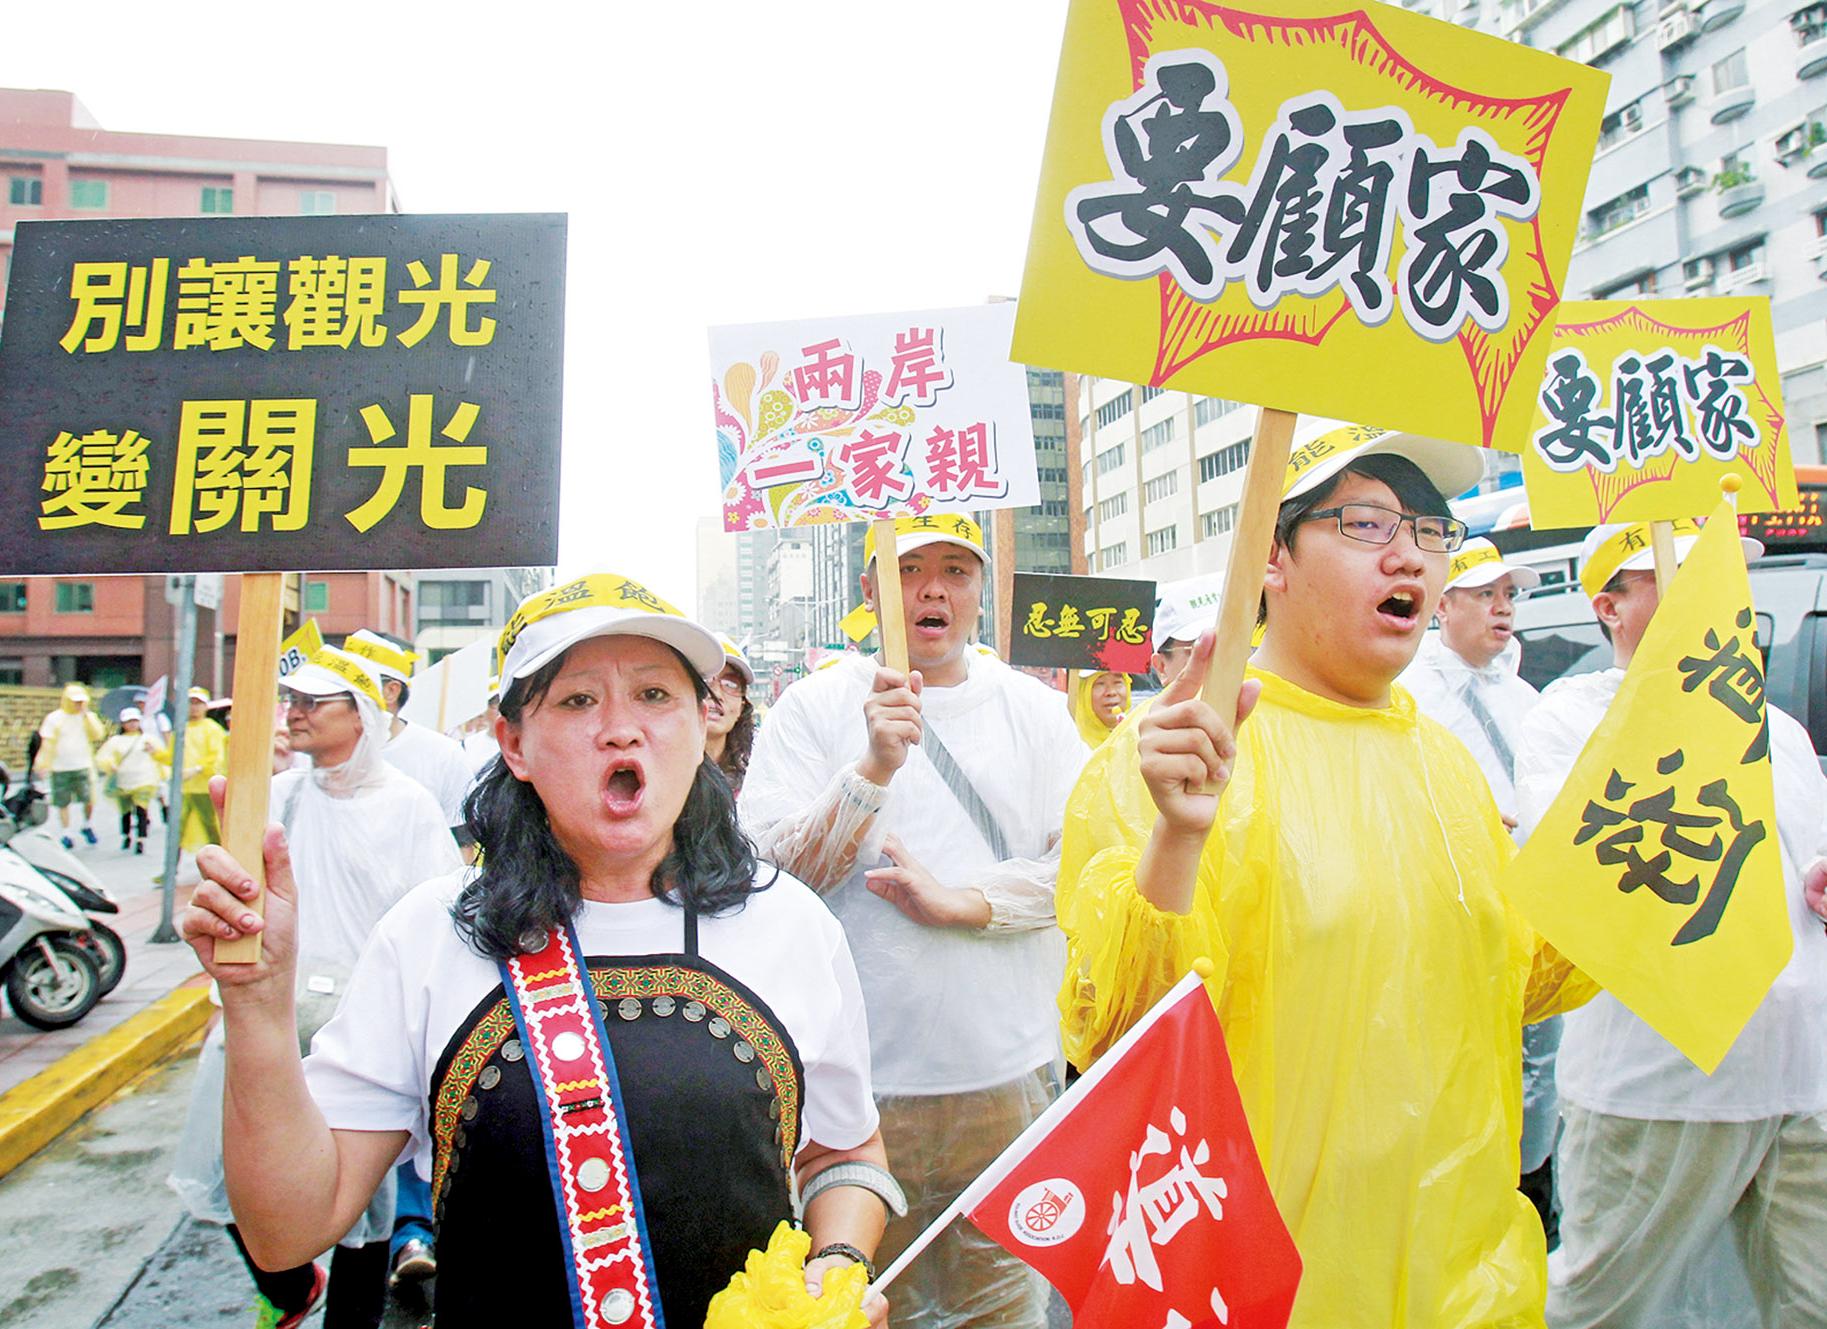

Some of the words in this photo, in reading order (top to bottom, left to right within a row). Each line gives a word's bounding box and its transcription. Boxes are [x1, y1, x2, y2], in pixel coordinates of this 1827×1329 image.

[1076, 62, 1531, 327] 要顧家
[59, 253, 497, 354] 別讓觀光
[793, 327, 945, 401] 兩岸
[1539, 352, 1755, 465] 要顧家
[37, 394, 489, 535] 變關光
[754, 422, 999, 500] 一家親
[895, 515, 973, 539] 生存
[1023, 602, 1148, 644] 忍無可忍
